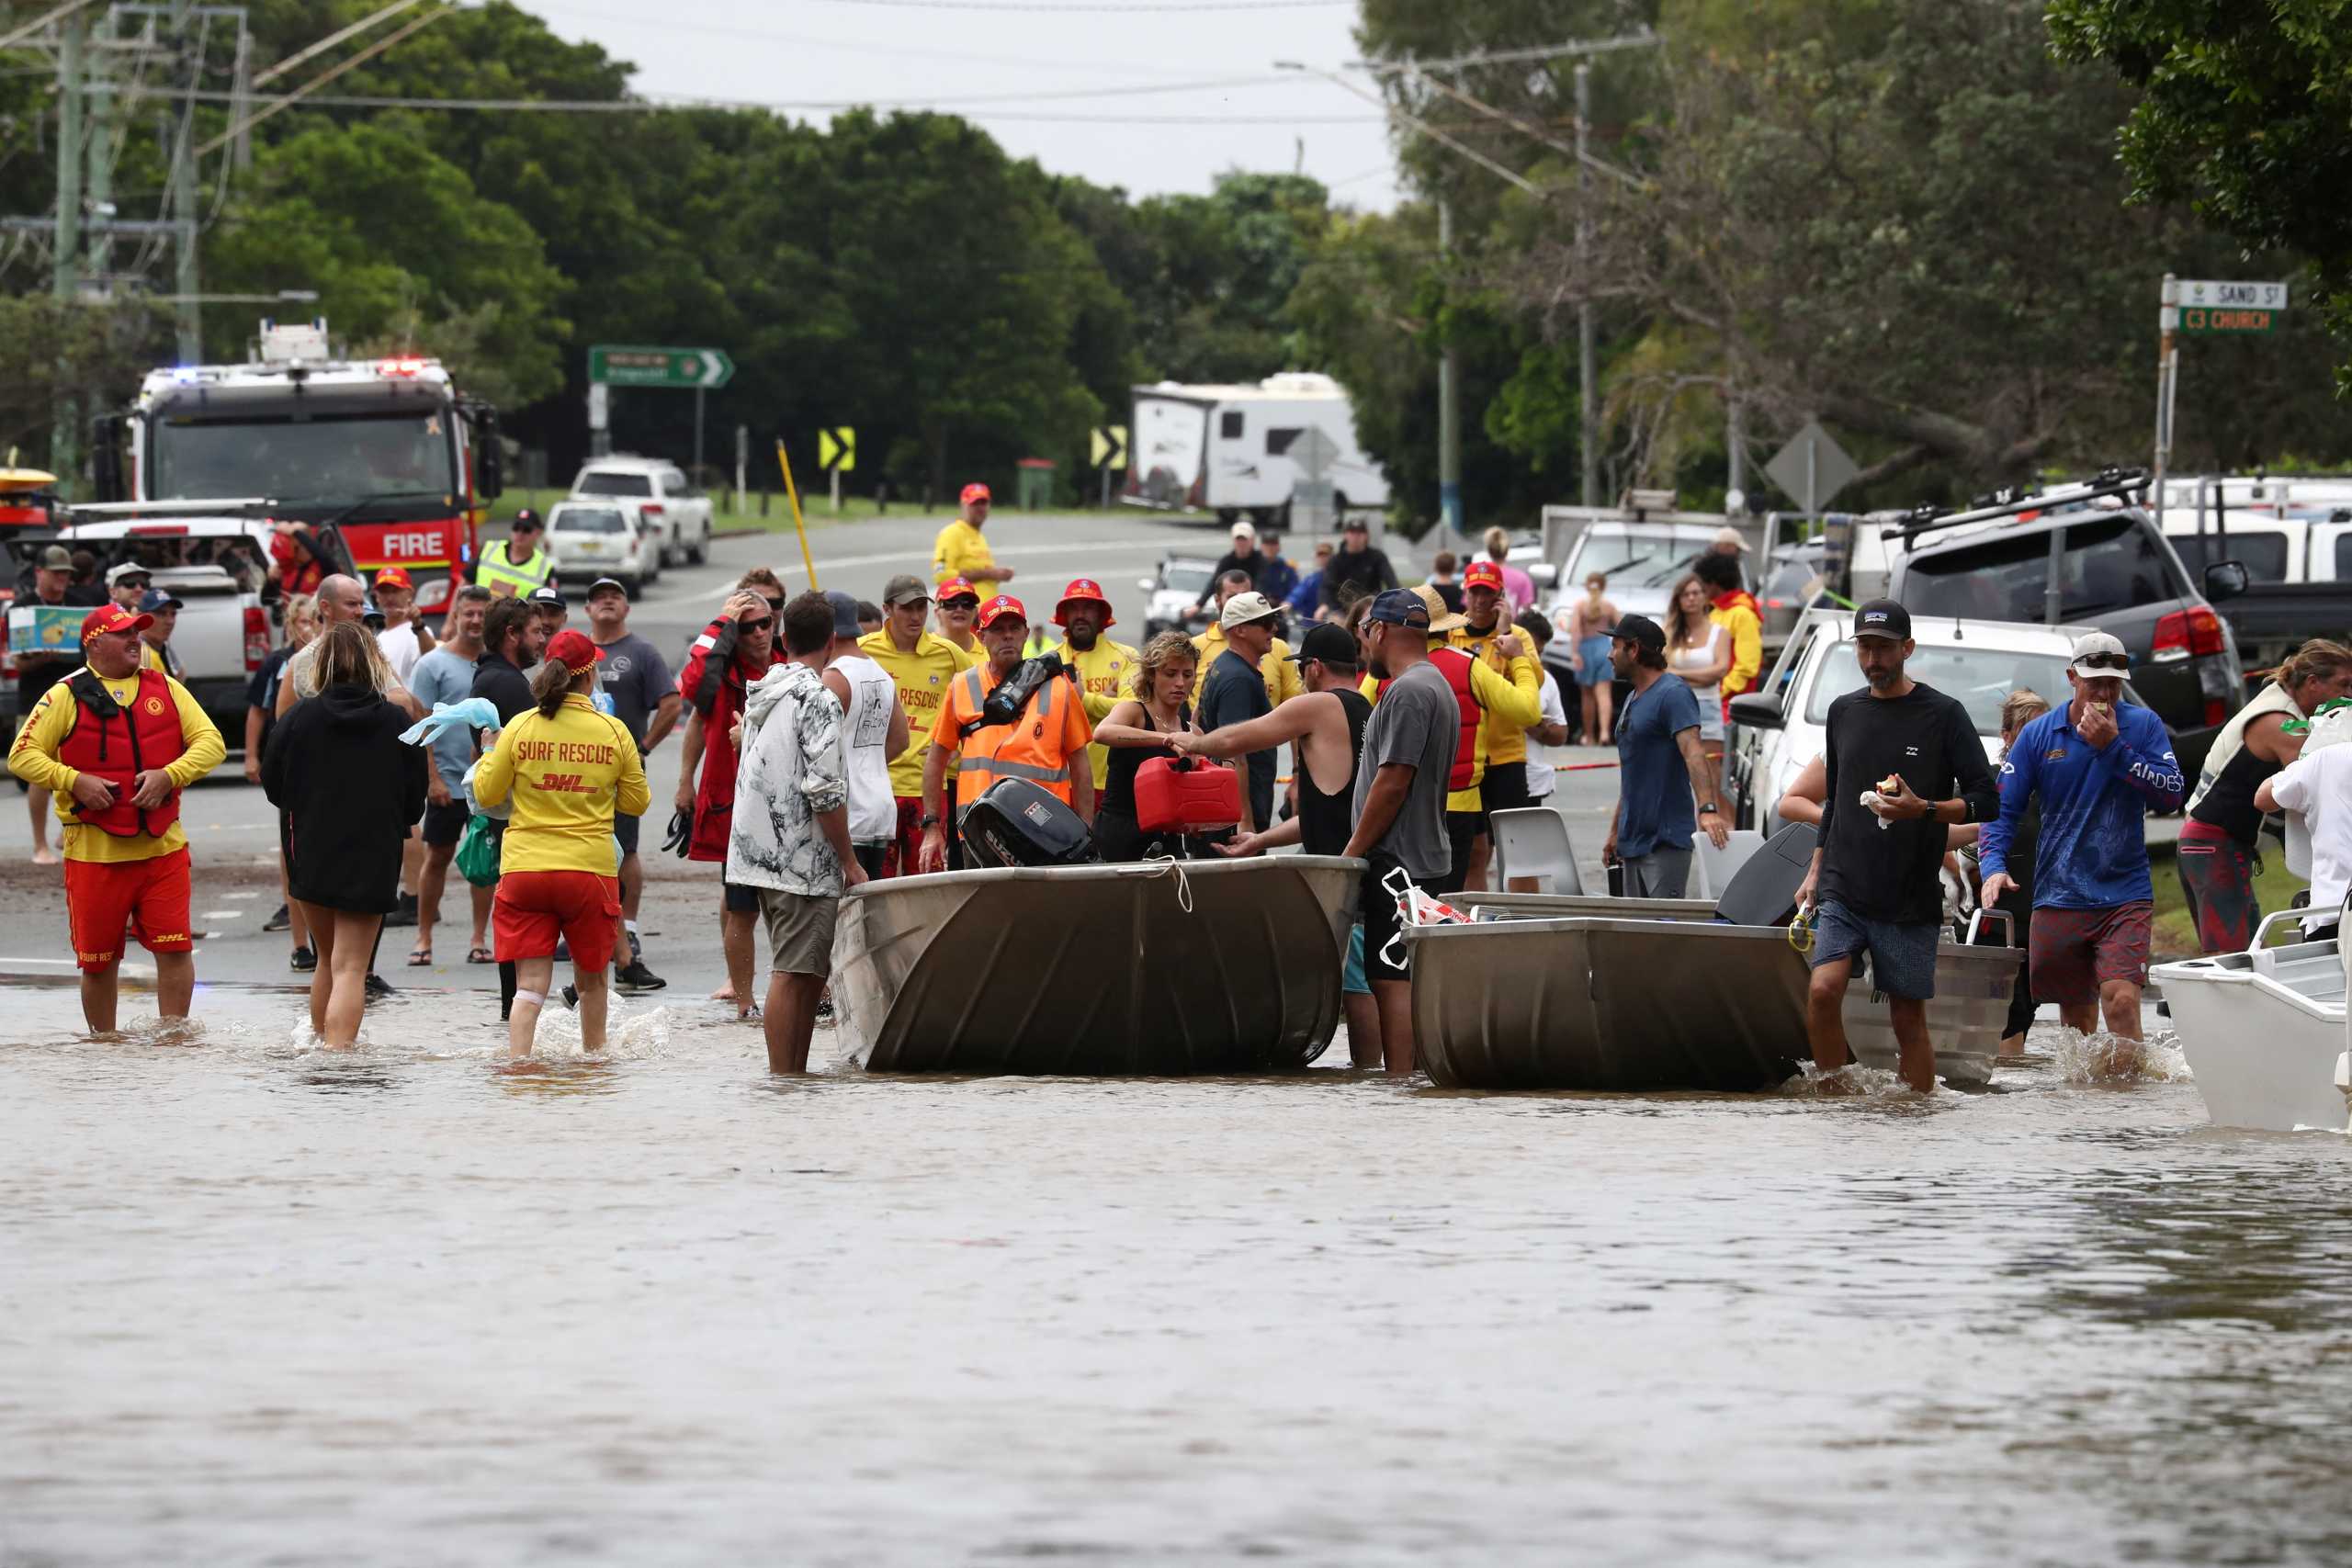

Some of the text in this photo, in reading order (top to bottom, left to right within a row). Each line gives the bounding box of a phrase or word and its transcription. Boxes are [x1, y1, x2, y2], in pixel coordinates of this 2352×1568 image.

[2219, 285, 2256, 304] SAND
[2187, 309, 2271, 329] C3 CHURCH
[383, 532, 444, 558] FIRE
[899, 688, 940, 710] RESCUE
[518, 741, 614, 765] SURF RESCUE
[531, 773, 598, 794] DHL
[985, 829, 1024, 868] SUZU
[153, 933, 187, 943] DHL
[84, 953, 97, 963] SURF
